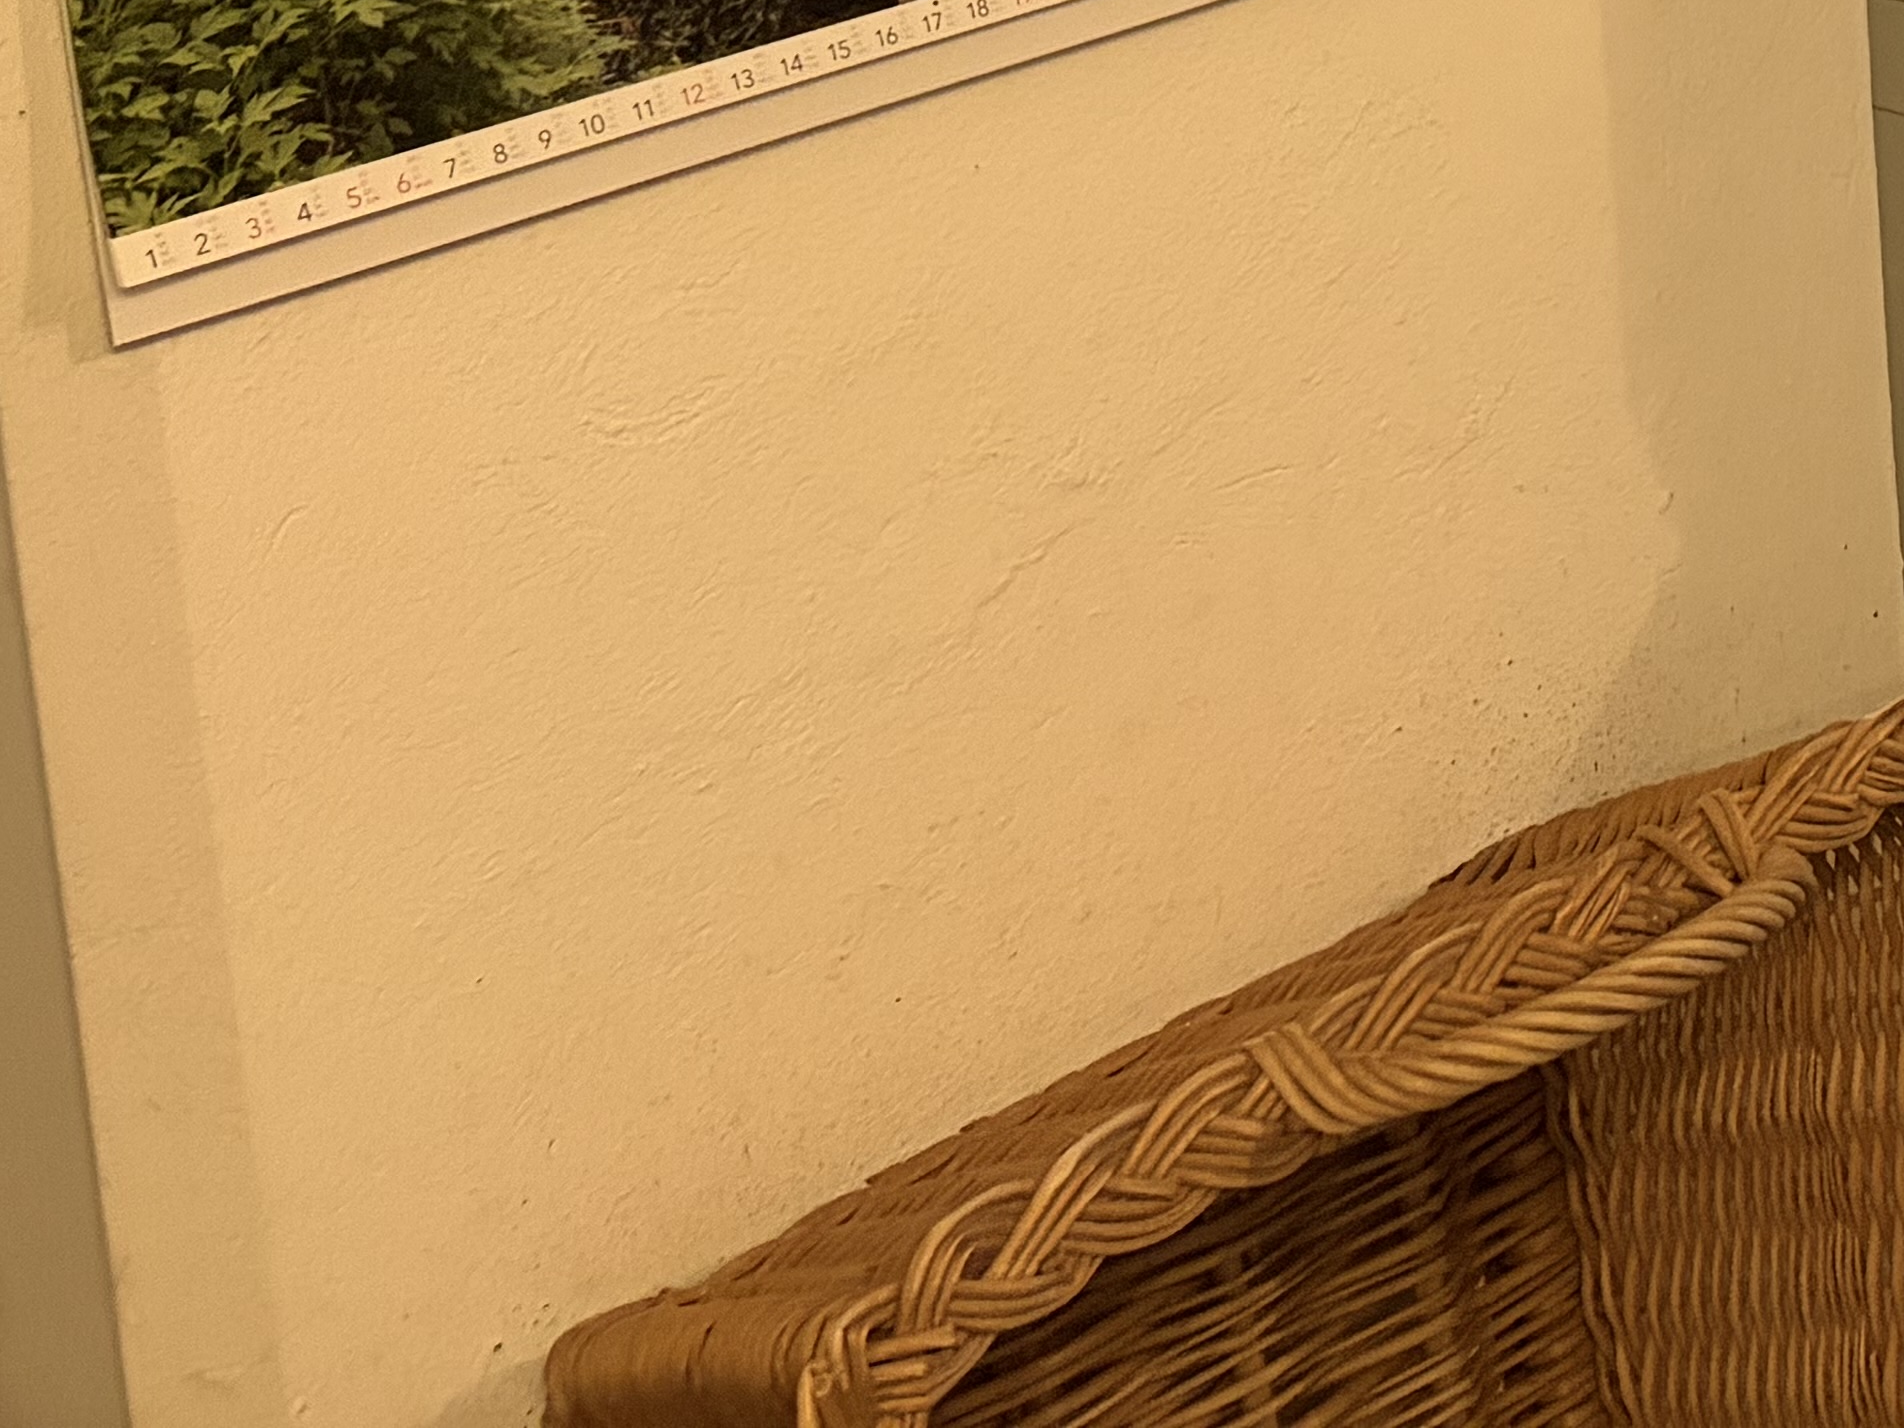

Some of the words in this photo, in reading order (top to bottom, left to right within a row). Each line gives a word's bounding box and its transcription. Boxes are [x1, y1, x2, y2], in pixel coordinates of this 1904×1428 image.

[145, 249, 158, 268] 1
[193, 233, 211, 255] 2
[245, 218, 262, 239] 3
[297, 202, 313, 222] 4
[346, 187, 362, 209] 5
[396, 173, 411, 193] 6
[443, 158, 456, 178] 7
[493, 143, 508, 163] 8
[538, 129, 552, 149] 9
[578, 114, 605, 137] 10
[632, 99, 655, 120] 11
[680, 83, 705, 106] 12
[730, 69, 755, 90] 13
[780, 53, 803, 75] 14
[827, 40, 851, 61] 15
[875, 26, 899, 47] 16
[922, 12, 942, 33] 17
